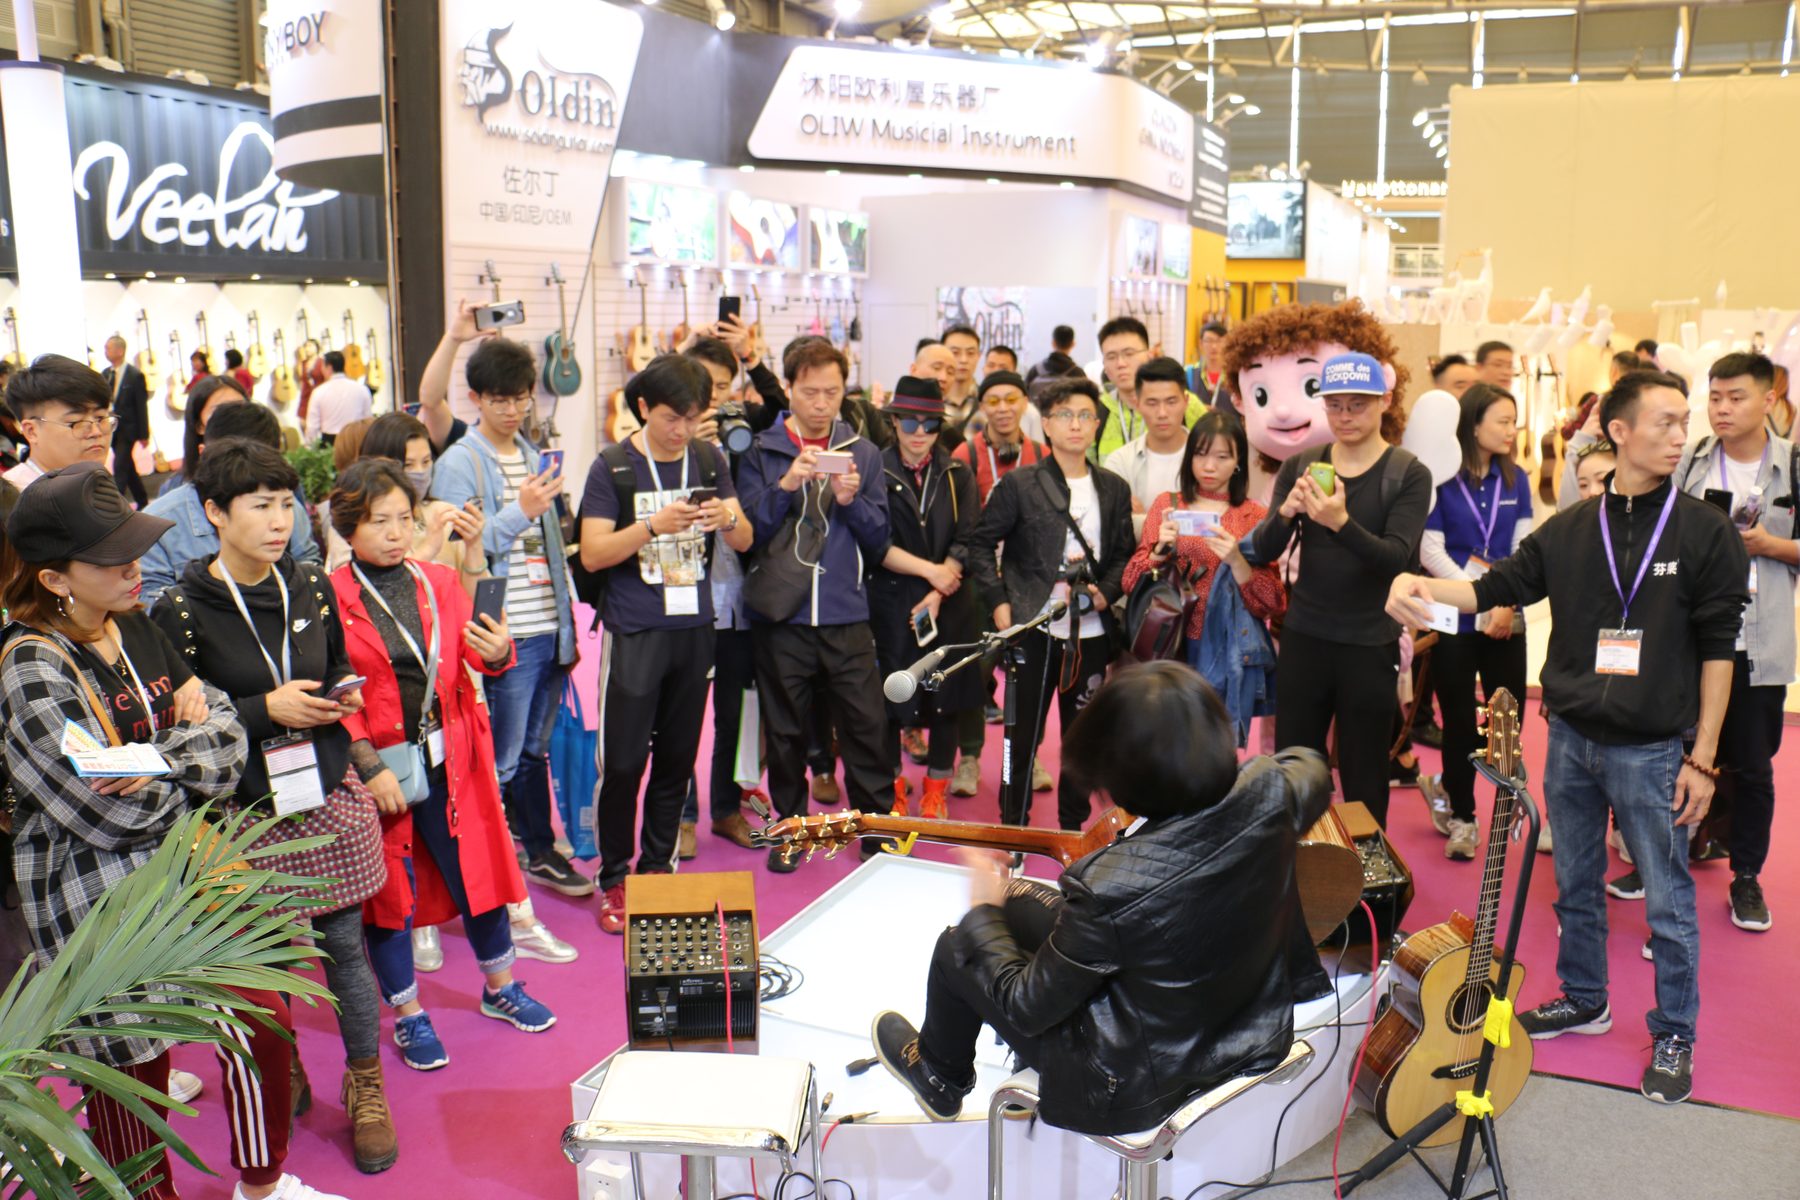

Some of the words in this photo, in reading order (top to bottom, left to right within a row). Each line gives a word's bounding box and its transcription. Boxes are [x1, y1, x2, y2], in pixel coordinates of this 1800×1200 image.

[800, 113, 864, 138] OLIW
[872, 119, 953, 144] Musicial
[963, 124, 1077, 154] Instrument
[503, 165, 559, 198] 佐尔丁
[1357, 363, 1371, 373] des
